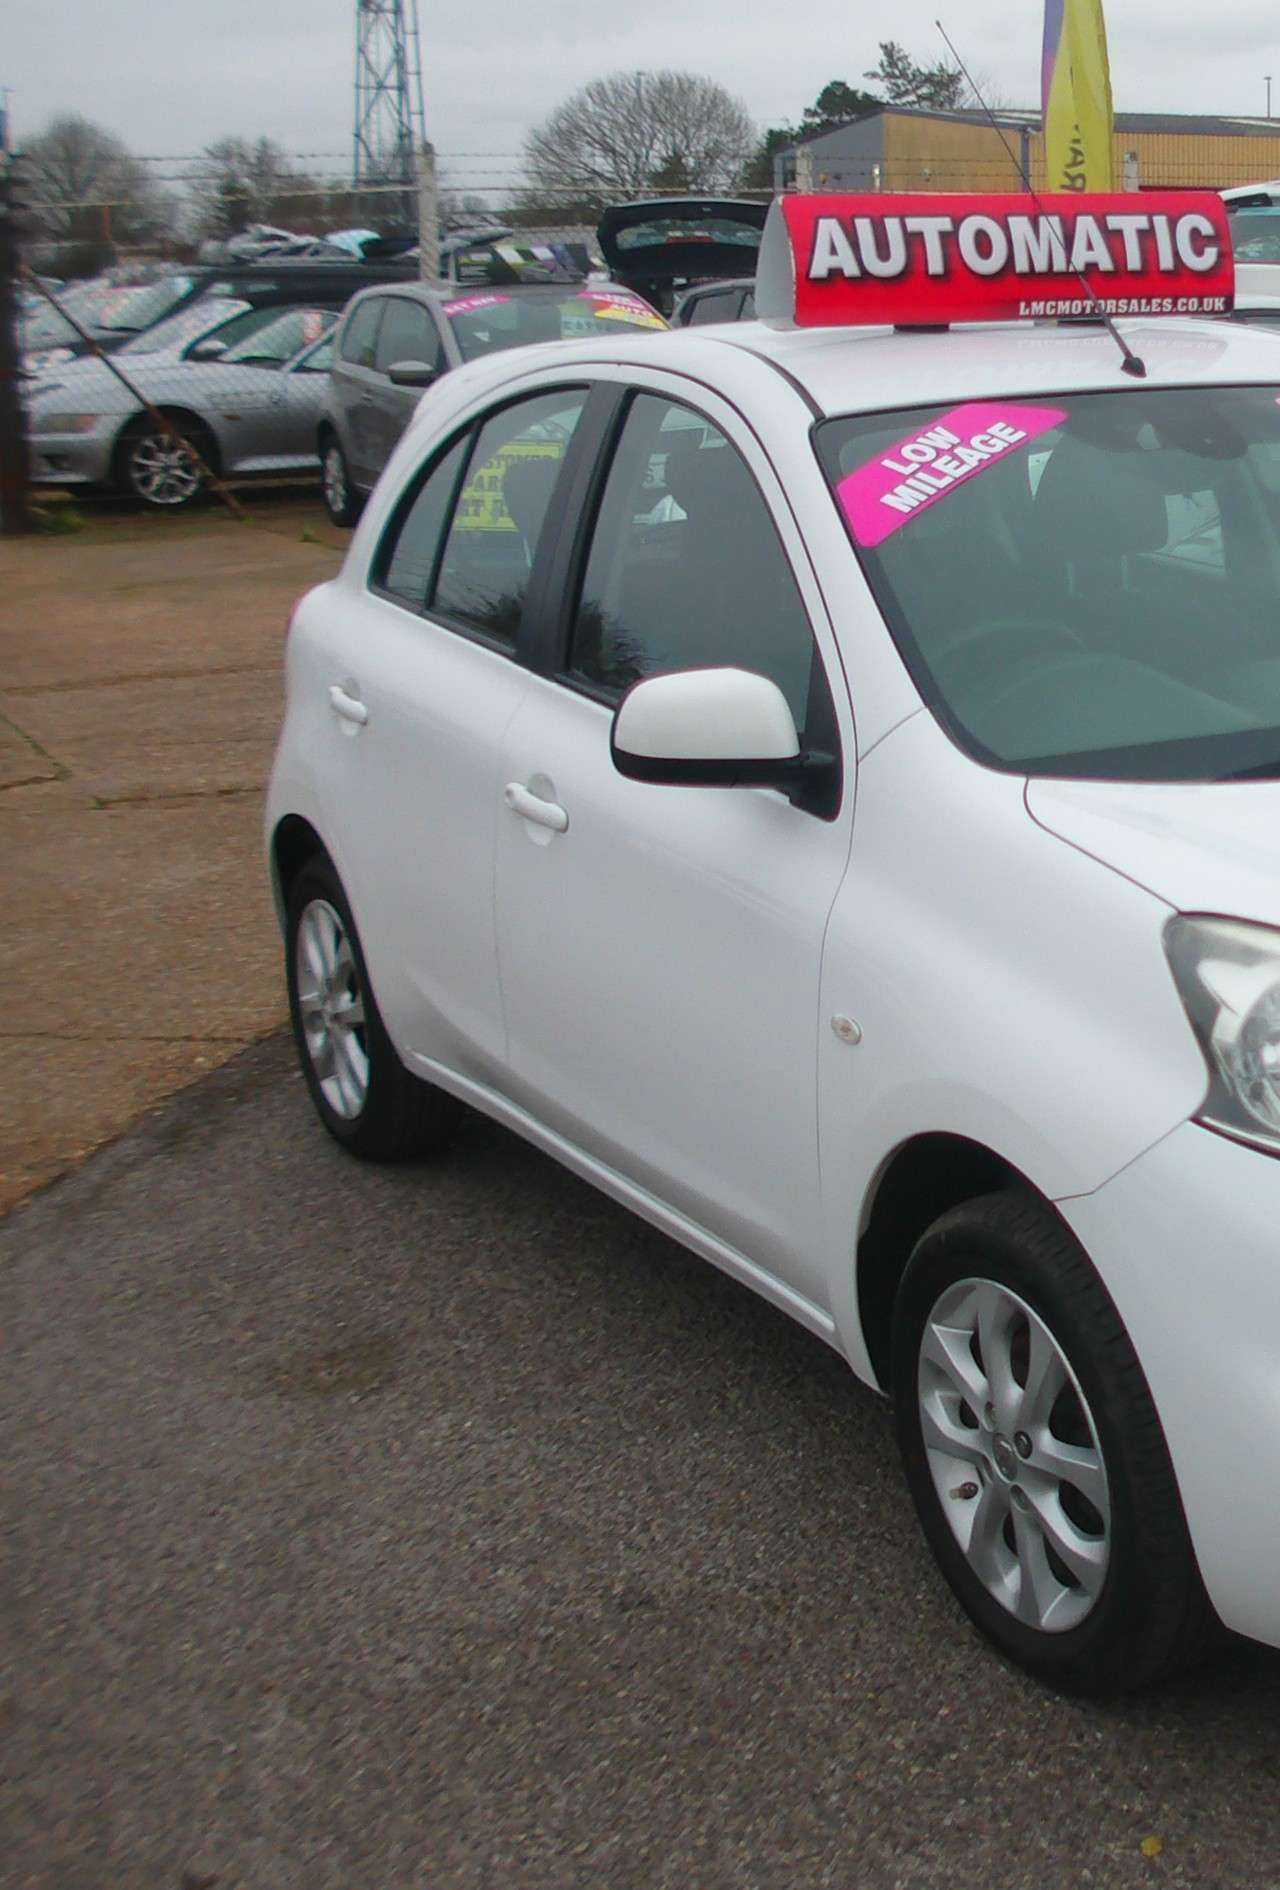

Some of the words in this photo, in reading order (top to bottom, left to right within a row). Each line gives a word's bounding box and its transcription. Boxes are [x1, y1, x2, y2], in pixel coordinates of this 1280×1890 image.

[809, 213, 1218, 278] AUTOMATIC
[879, 421, 1028, 514] MILEAGE
[880, 425, 961, 476] LOW
